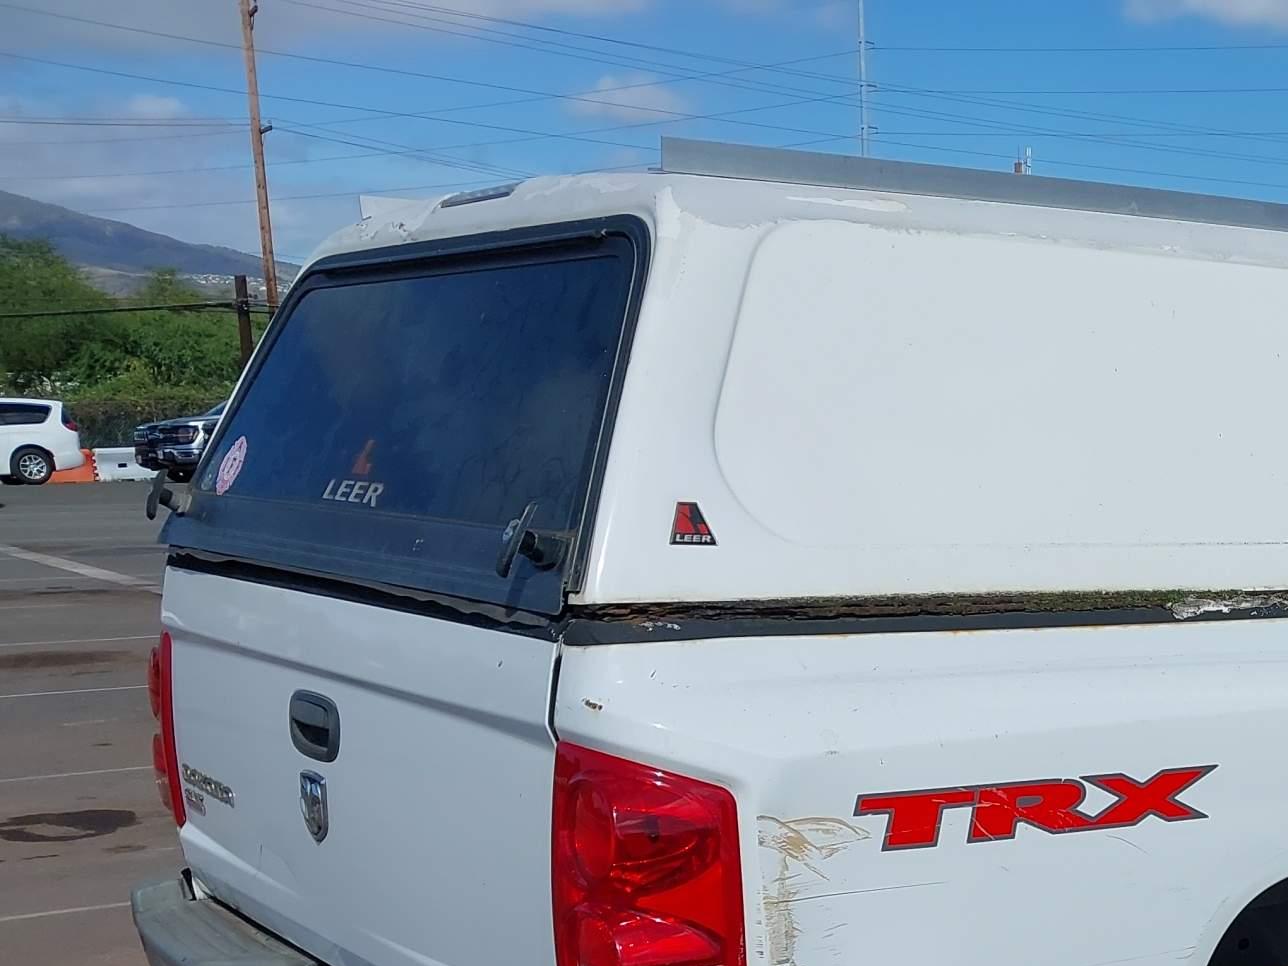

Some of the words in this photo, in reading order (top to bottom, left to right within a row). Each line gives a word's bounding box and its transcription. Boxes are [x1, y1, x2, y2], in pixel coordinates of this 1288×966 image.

[322, 478, 384, 507] LEER
[675, 533, 712, 543] LEER
[853, 764, 1219, 851] TRX
